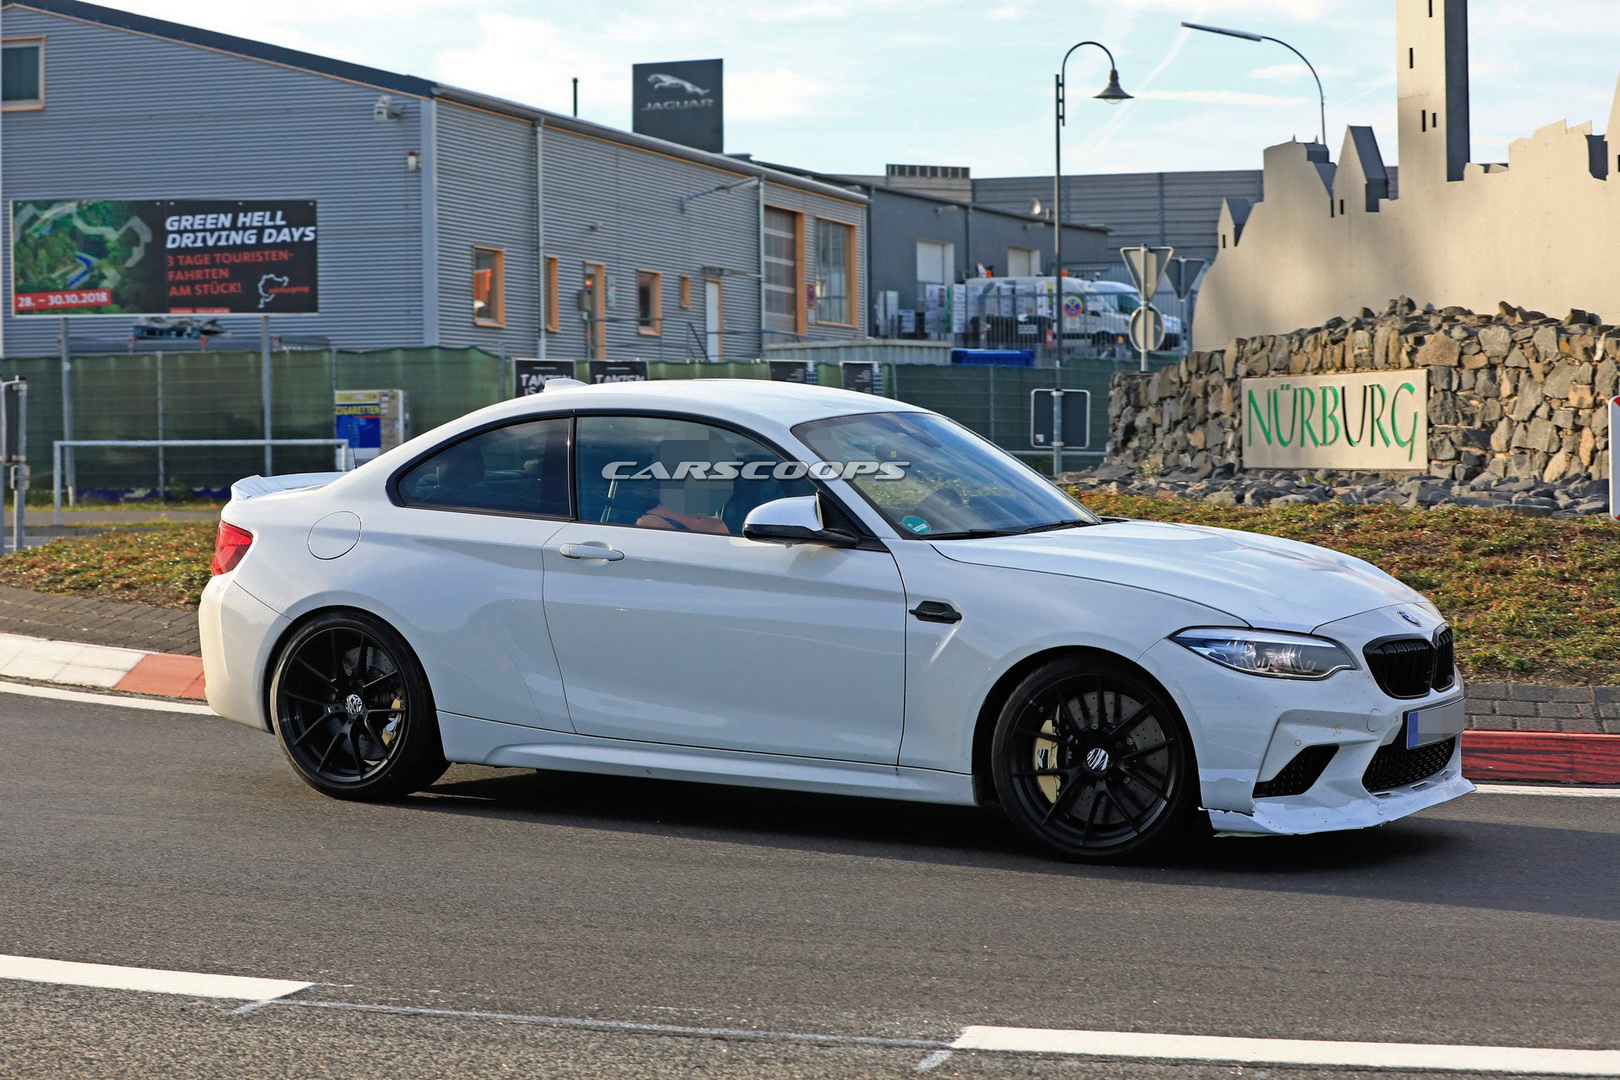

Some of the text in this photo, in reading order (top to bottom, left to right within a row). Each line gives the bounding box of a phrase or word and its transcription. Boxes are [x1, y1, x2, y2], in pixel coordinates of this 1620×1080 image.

[641, 98, 713, 111] JAGUAR
[165, 210, 287, 231] GREEN HELL
[166, 226, 316, 248] DRIVING DAYS
[177, 254, 211, 266] TAGE
[214, 250, 294, 264] TOURISTEN-
[168, 268, 229, 281] FAHRTEN
[169, 281, 242, 296] AM STÜCK!
[17, 296, 36, 307] 28.
[48, 292, 108, 306] 30.10.2018
[1247, 383, 1418, 461] NÜRBURG
